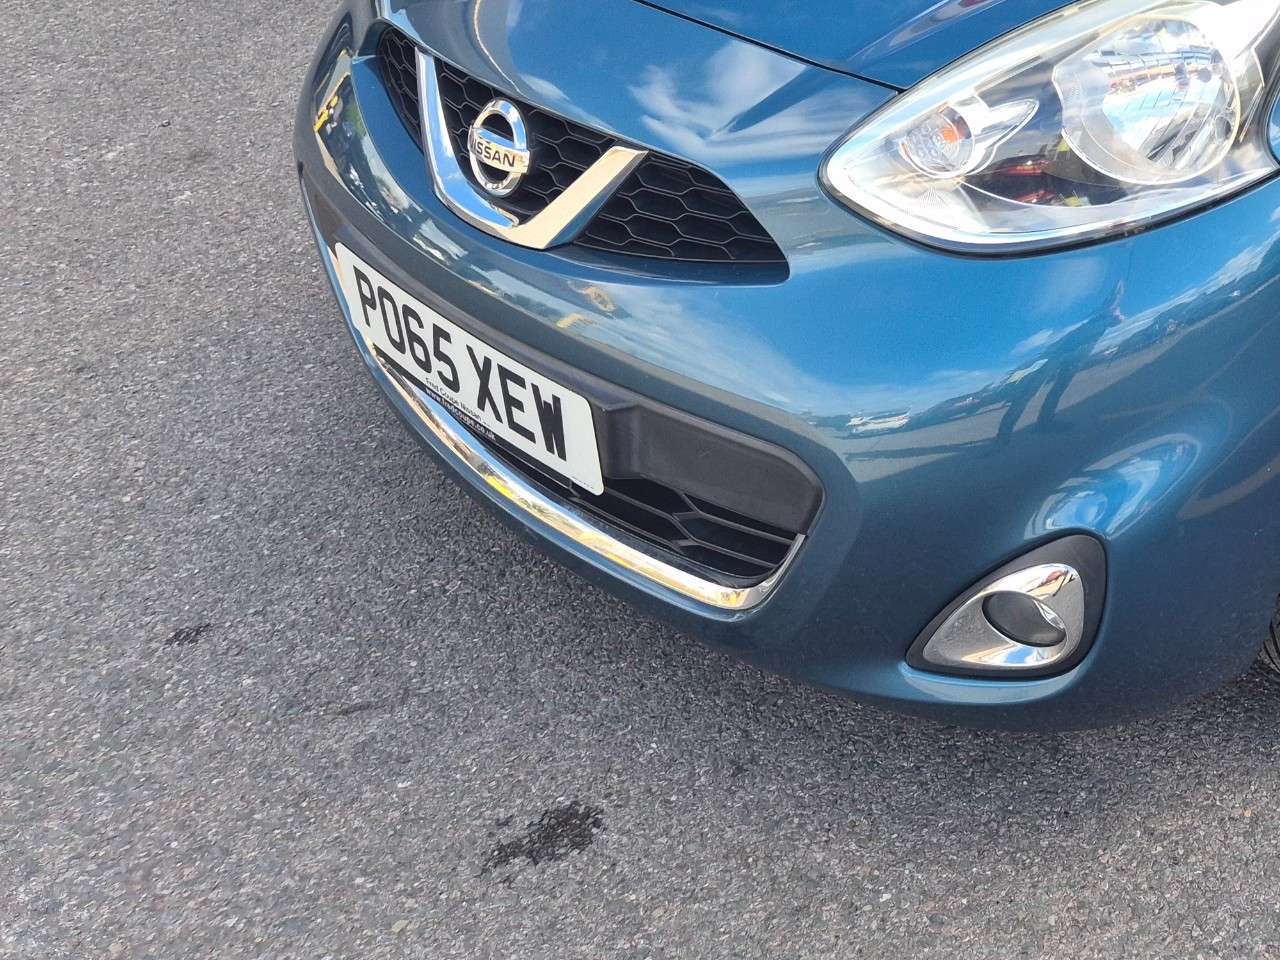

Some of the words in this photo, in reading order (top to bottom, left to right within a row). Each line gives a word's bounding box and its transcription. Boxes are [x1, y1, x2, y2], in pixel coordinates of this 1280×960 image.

[353, 265, 461, 394] PO65
[465, 344, 567, 462] XEW
[425, 377, 440, 391] Fred
[440, 388, 460, 407] Coupe
[460, 401, 482, 421] Nissan
[425, 387, 497, 441] www.fredcoupe.co.uk
